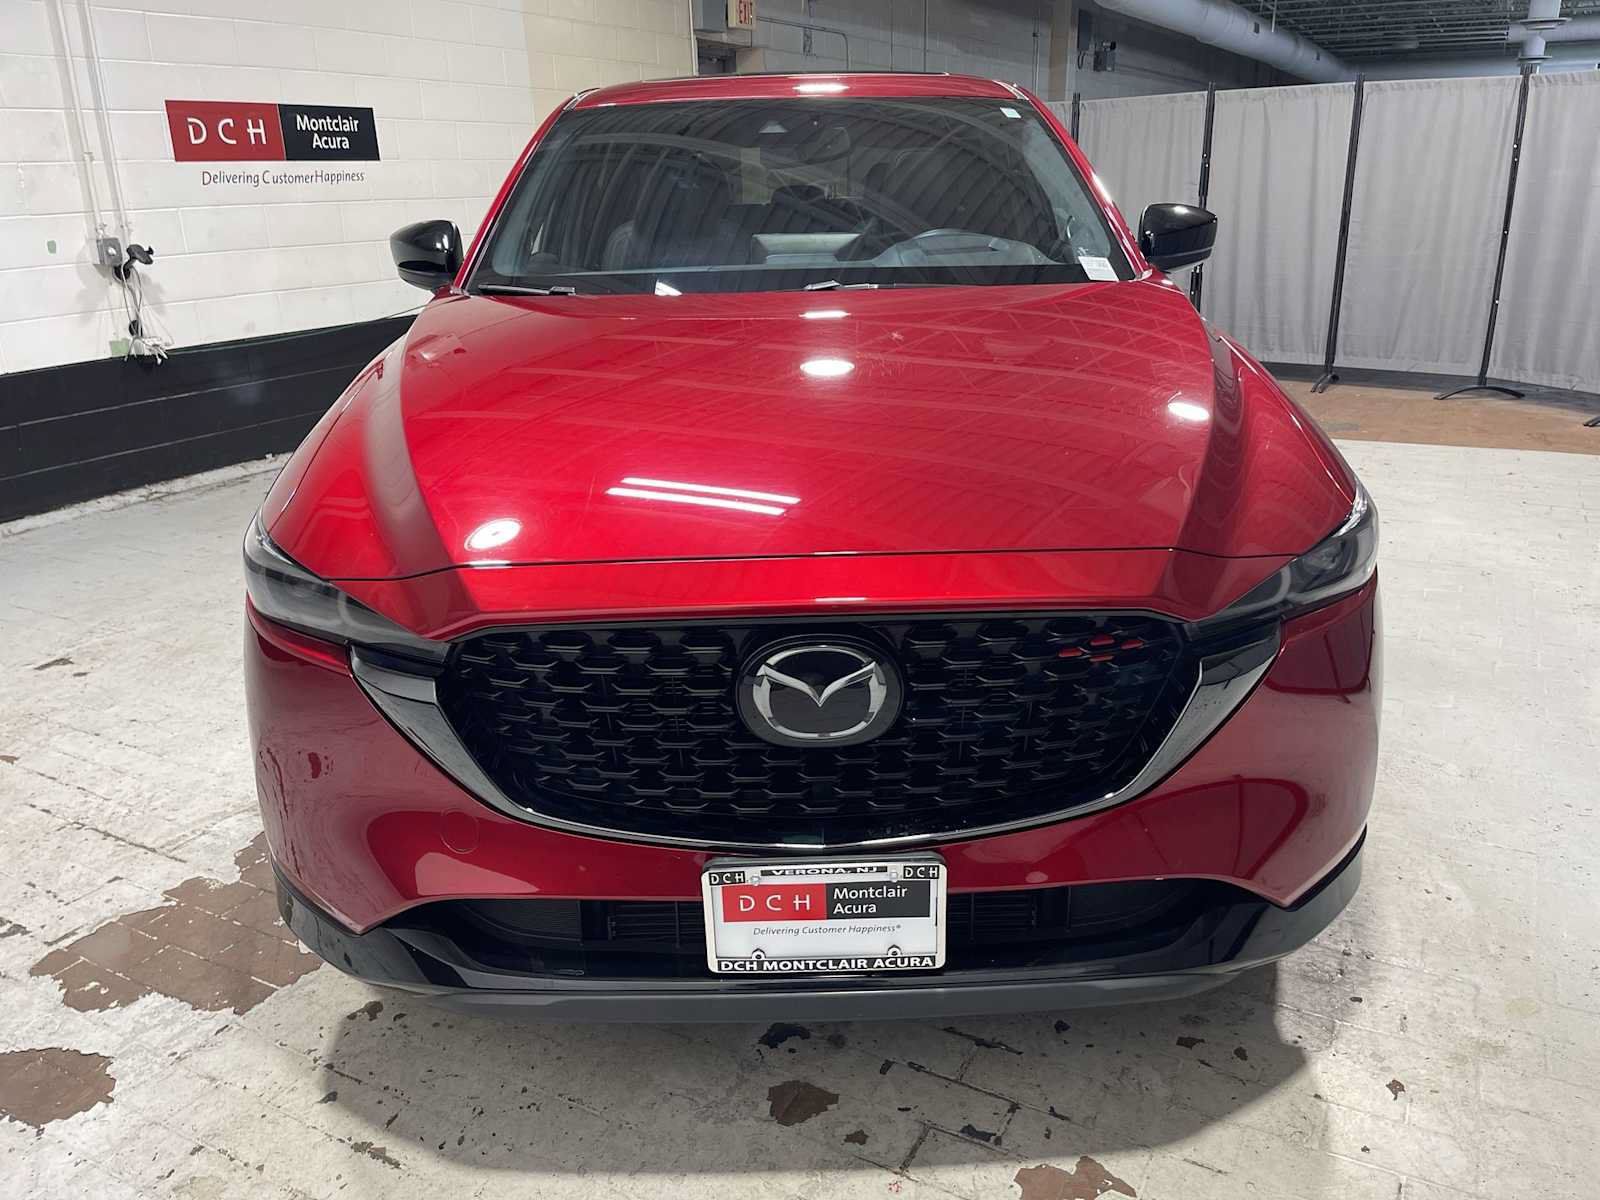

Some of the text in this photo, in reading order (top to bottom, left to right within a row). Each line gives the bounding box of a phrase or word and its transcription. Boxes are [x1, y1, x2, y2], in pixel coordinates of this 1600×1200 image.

[296, 114, 359, 133] Montclair
[186, 117, 267, 145] DCH
[312, 133, 350, 150] Acura
[202, 171, 260, 187] Delivering
[710, 873, 745, 885] DCH
[904, 867, 939, 878] DCH
[833, 886, 908, 900] Montclair
[739, 894, 811, 912] DCH
[833, 903, 877, 914] Acura
[753, 927, 800, 936] Delivering
[802, 925, 846, 934] Customer
[720, 957, 933, 971] DCH MONTCLAIR ACURA
